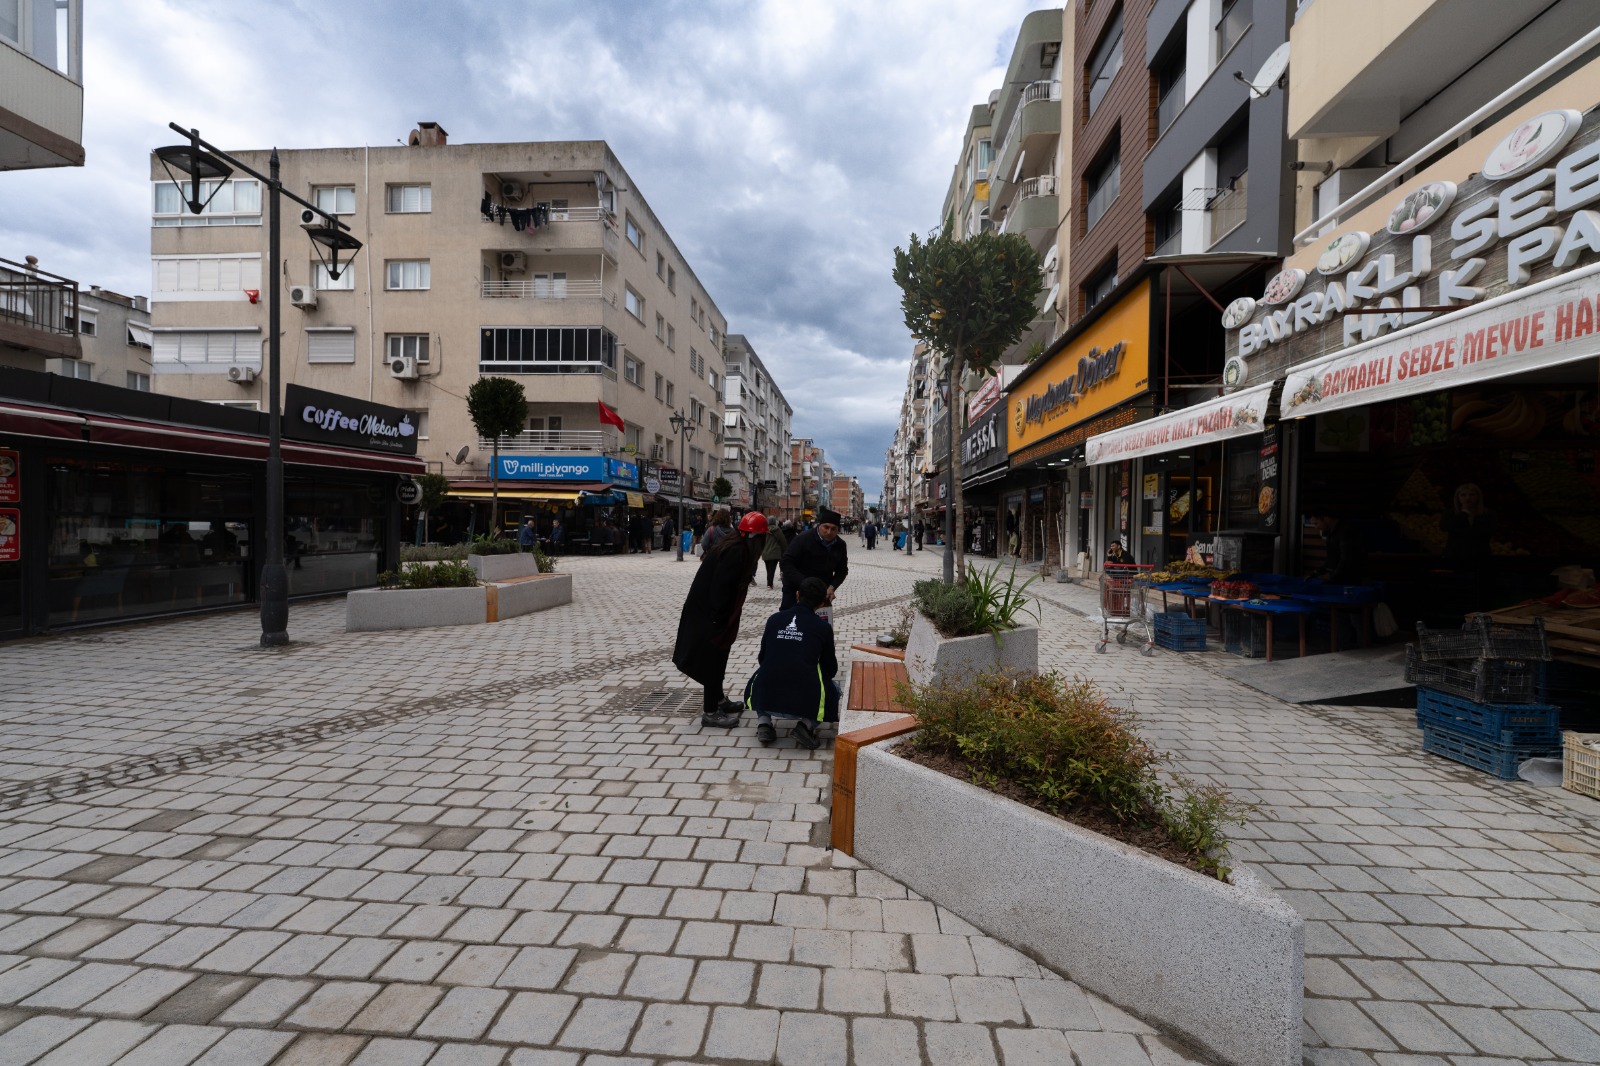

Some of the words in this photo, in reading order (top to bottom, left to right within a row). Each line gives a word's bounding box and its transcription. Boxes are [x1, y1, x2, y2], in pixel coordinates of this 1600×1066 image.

[1239, 235, 1431, 357] BAYRAKLI
[1343, 258, 1486, 347] HALK
[1077, 340, 1126, 393] Döner
[1321, 355, 1393, 398] BAYRAKLI
[1397, 337, 1457, 380] SEBZE
[1462, 311, 1545, 365] MEYVE
[1555, 293, 1600, 343] HA
[303, 405, 358, 430] Coffee
[1145, 426, 1170, 447] MEYVE
[1172, 421, 1194, 441] HALK
[1196, 406, 1233, 435] PAZARI
[520, 463, 543, 473] milli
[545, 463, 589, 475] piyango
